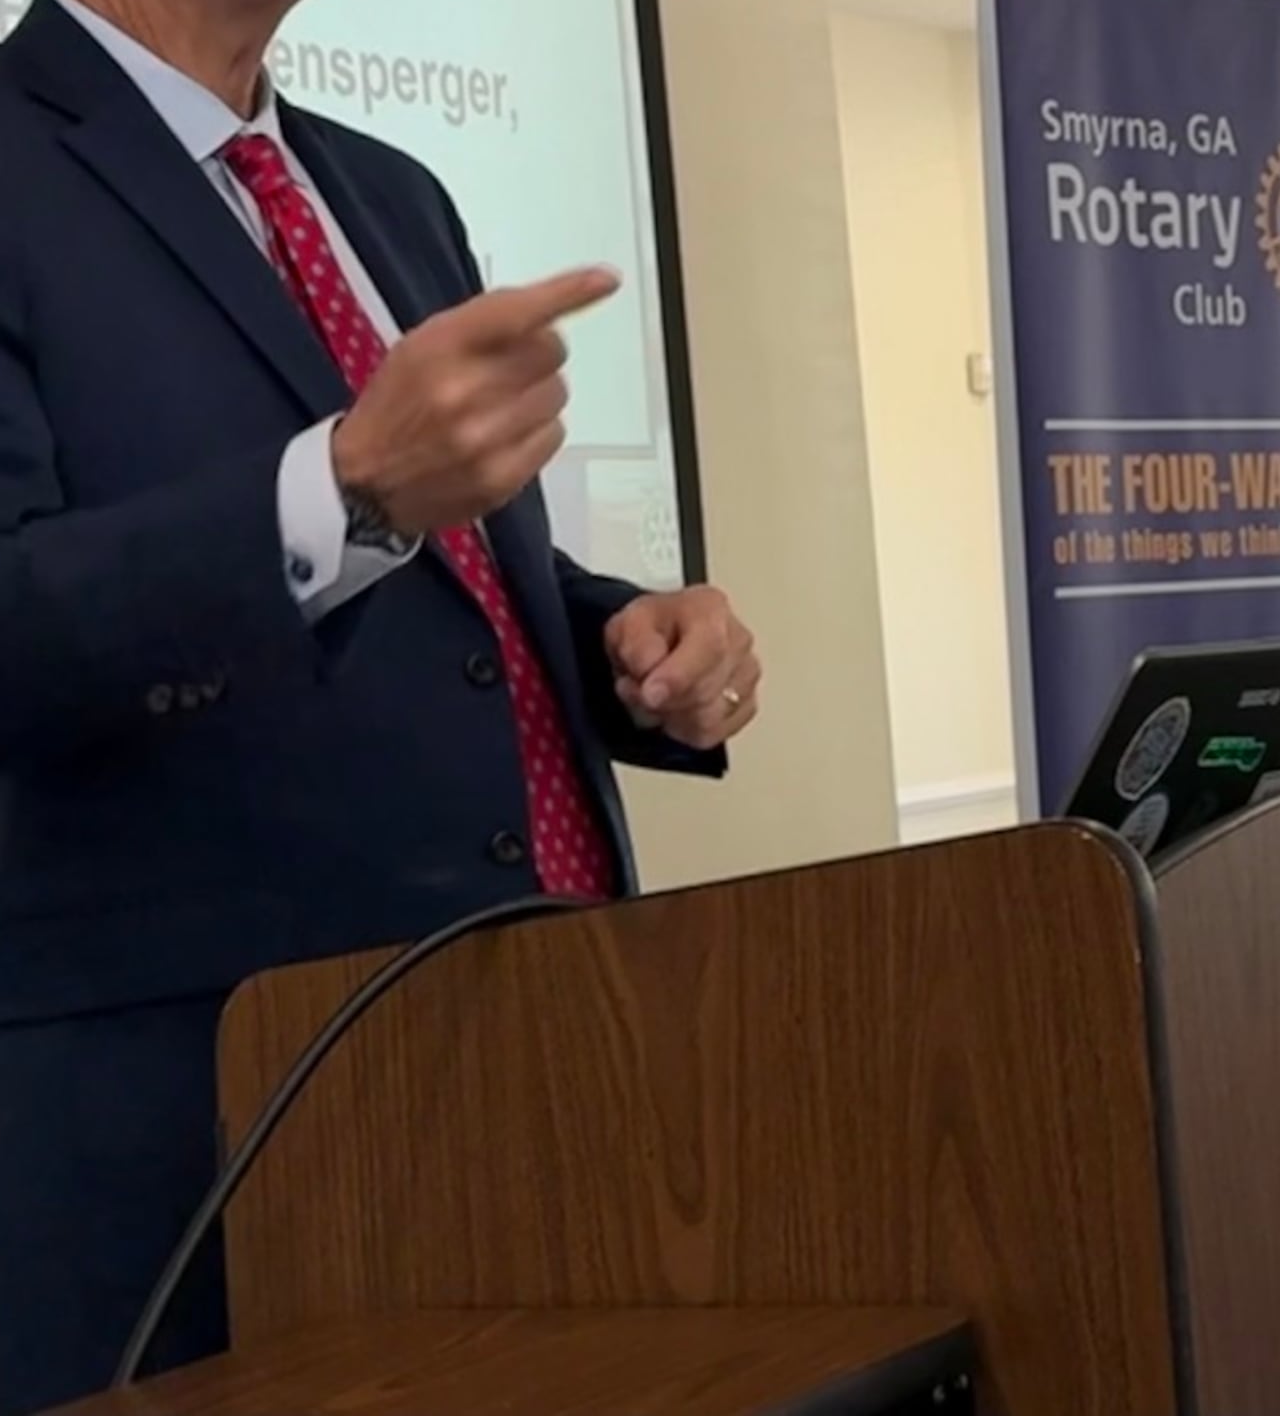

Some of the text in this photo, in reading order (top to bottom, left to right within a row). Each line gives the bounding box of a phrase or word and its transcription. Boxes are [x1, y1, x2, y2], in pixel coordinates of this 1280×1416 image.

[272, 37, 518, 133] ensperger,
[1041, 99, 1237, 156] Smyrna, GA
[1047, 162, 1240, 268] Rotary
[1173, 283, 1246, 325] Club
[1047, 454, 1112, 515] THE
[1054, 531, 1077, 564] of
[1085, 531, 1115, 563] the
[1124, 528, 1192, 564] things
[1200, 531, 1232, 557] we
